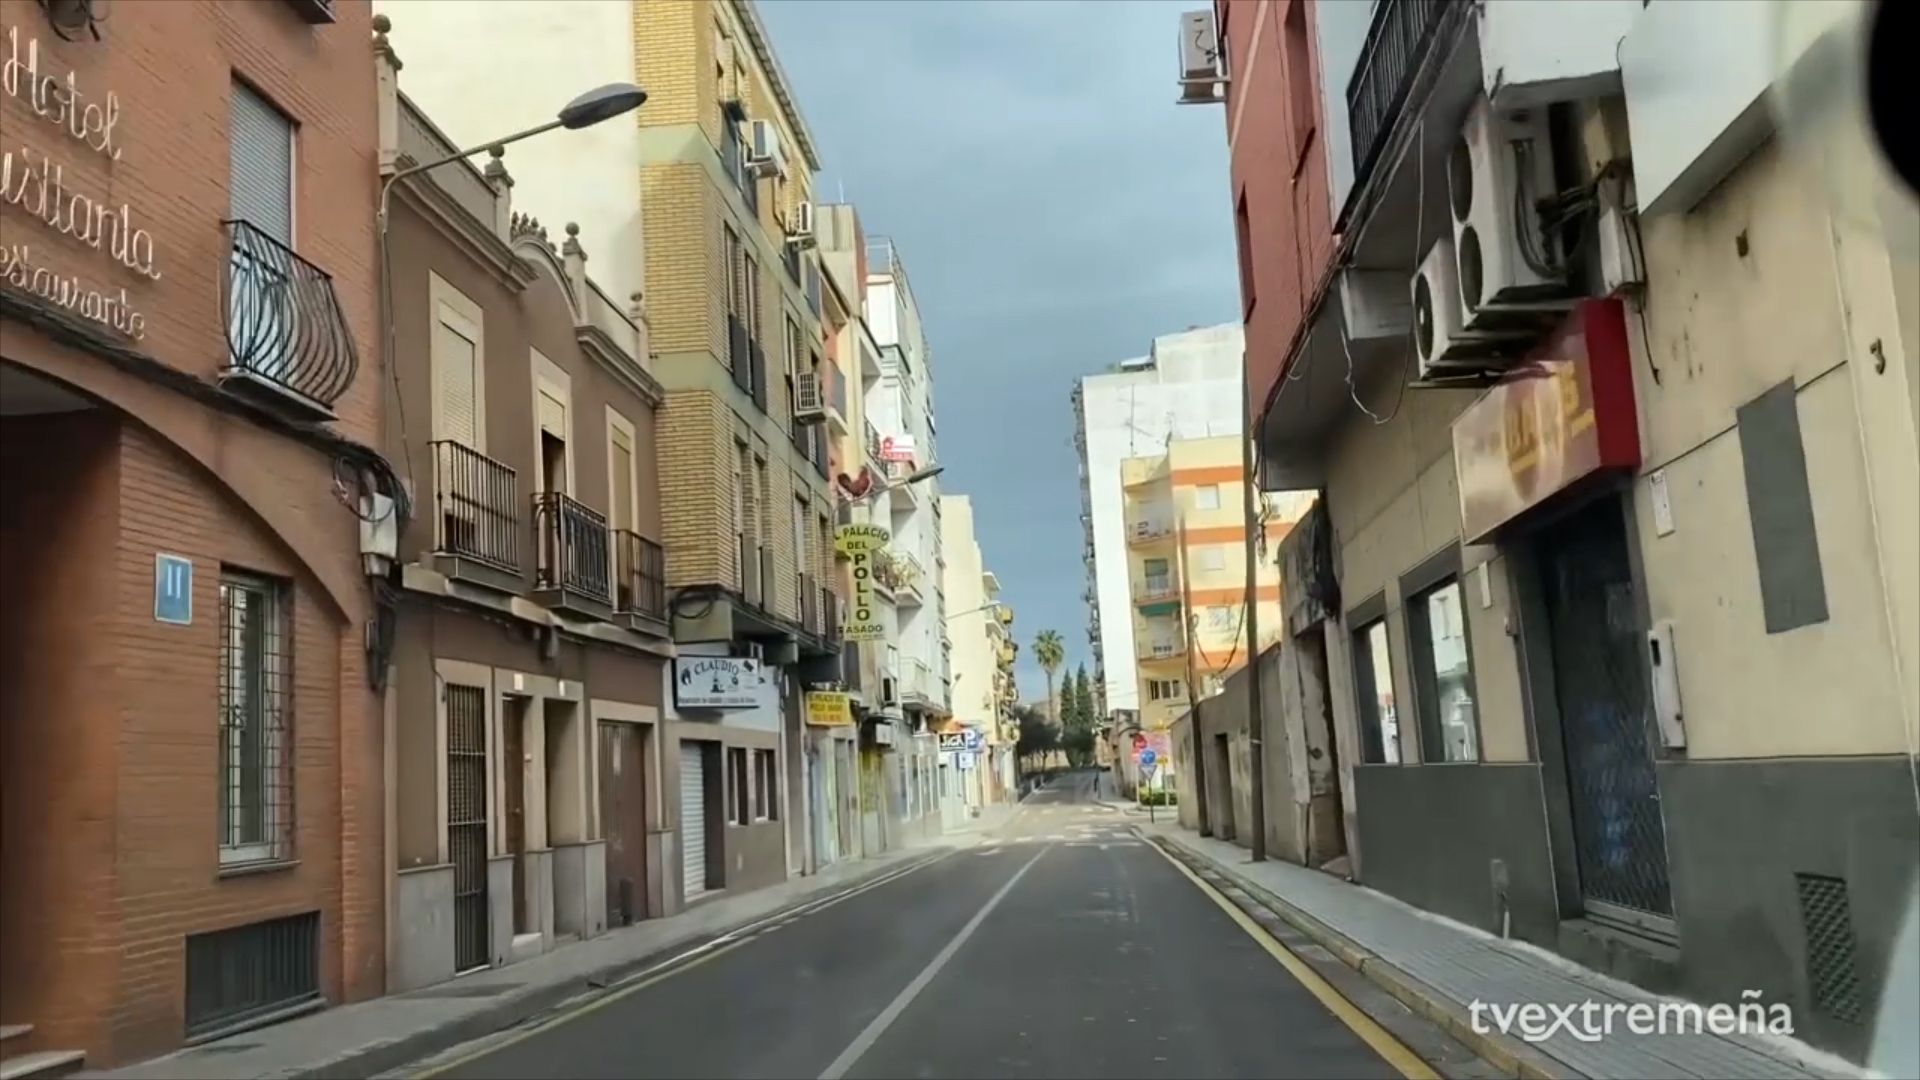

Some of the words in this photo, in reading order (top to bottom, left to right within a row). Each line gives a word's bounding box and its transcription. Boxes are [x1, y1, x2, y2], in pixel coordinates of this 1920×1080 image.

[3, 26, 121, 160] Hotel
[842, 527, 889, 542] PALACIO
[847, 541, 869, 550] DEL
[854, 553, 870, 621] POLLO
[694, 660, 739, 676] CLAUDIO
